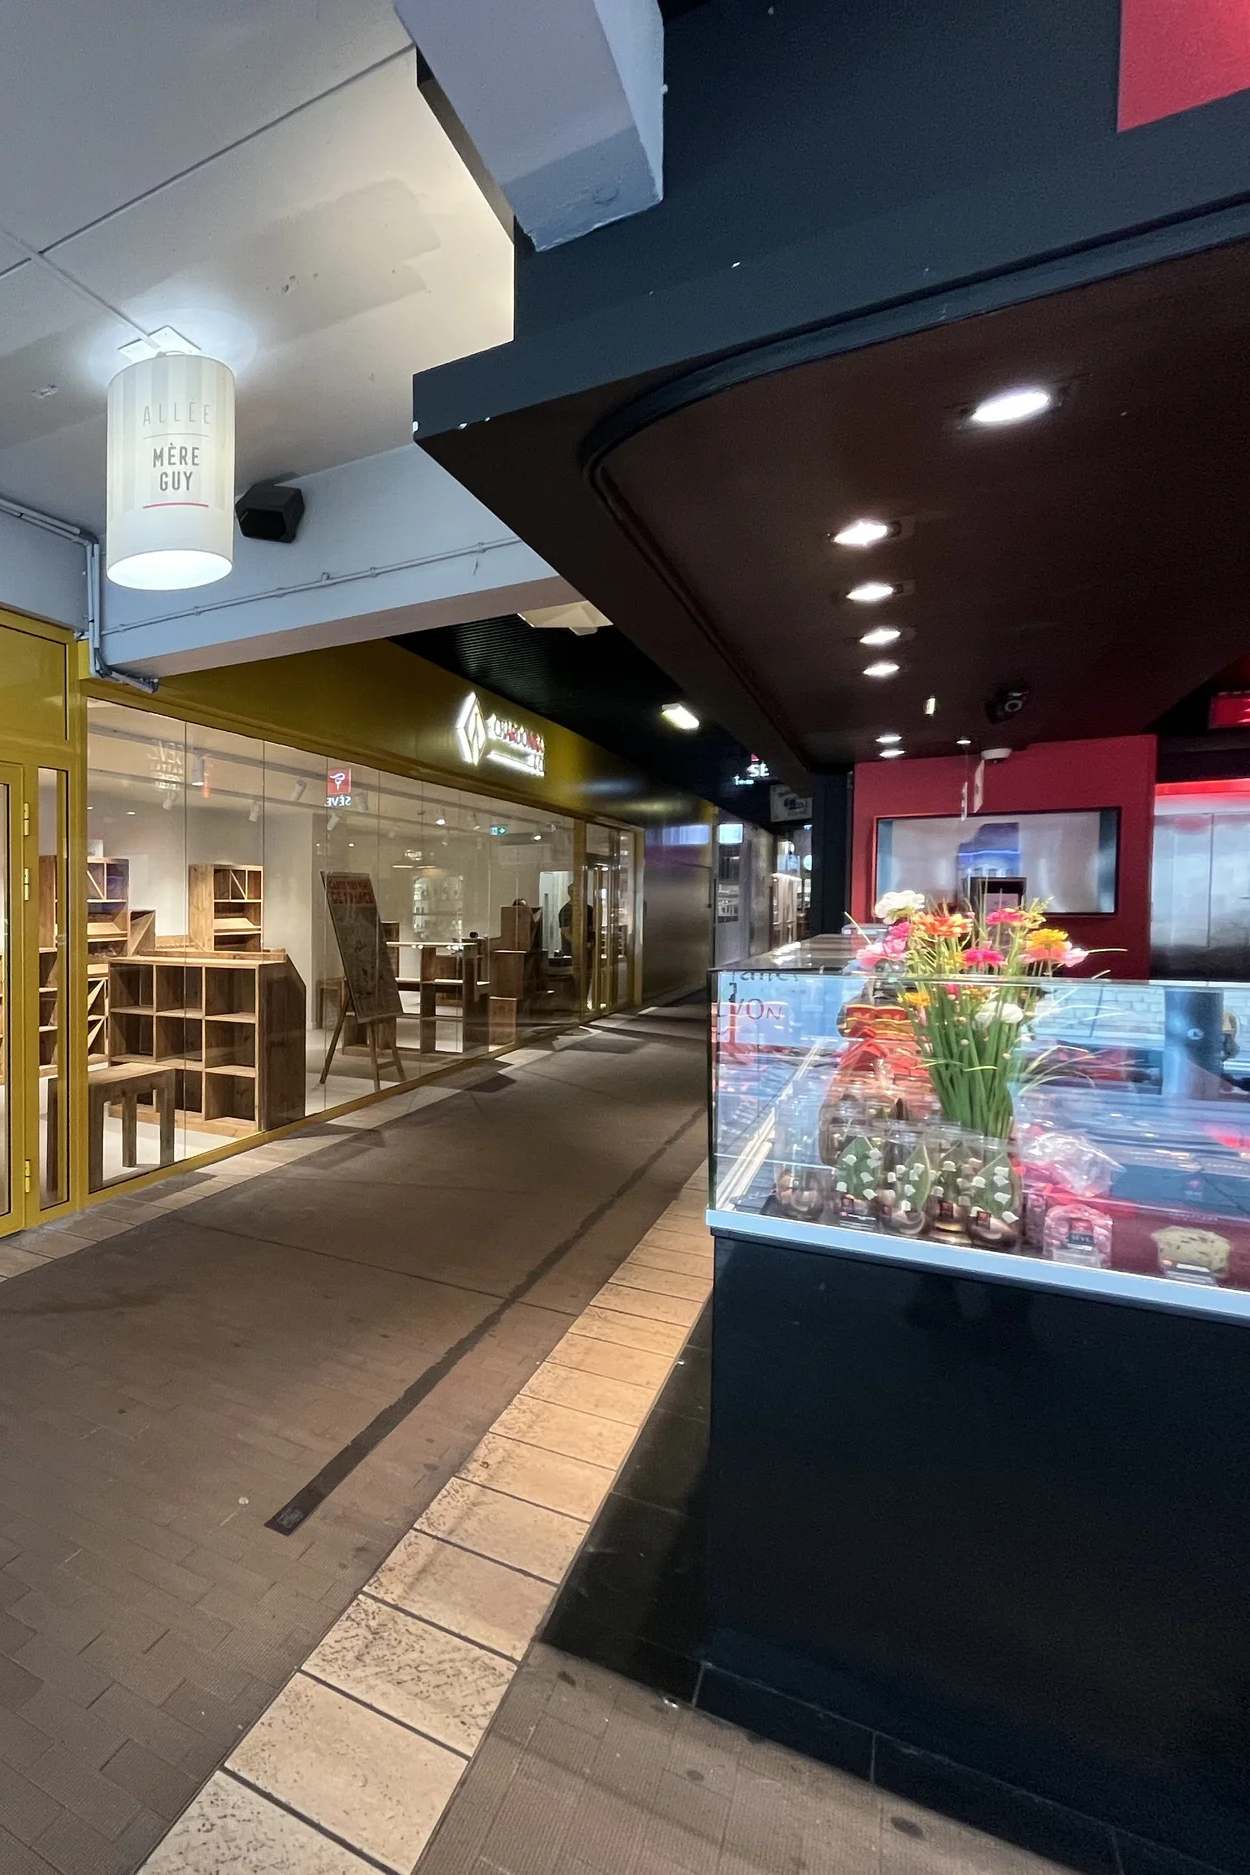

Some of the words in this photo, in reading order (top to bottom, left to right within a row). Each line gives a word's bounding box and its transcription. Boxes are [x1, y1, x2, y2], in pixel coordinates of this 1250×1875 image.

[143, 397, 210, 426] ALLÉE
[153, 442, 200, 468] MÈRE
[159, 471, 194, 492] GUY
